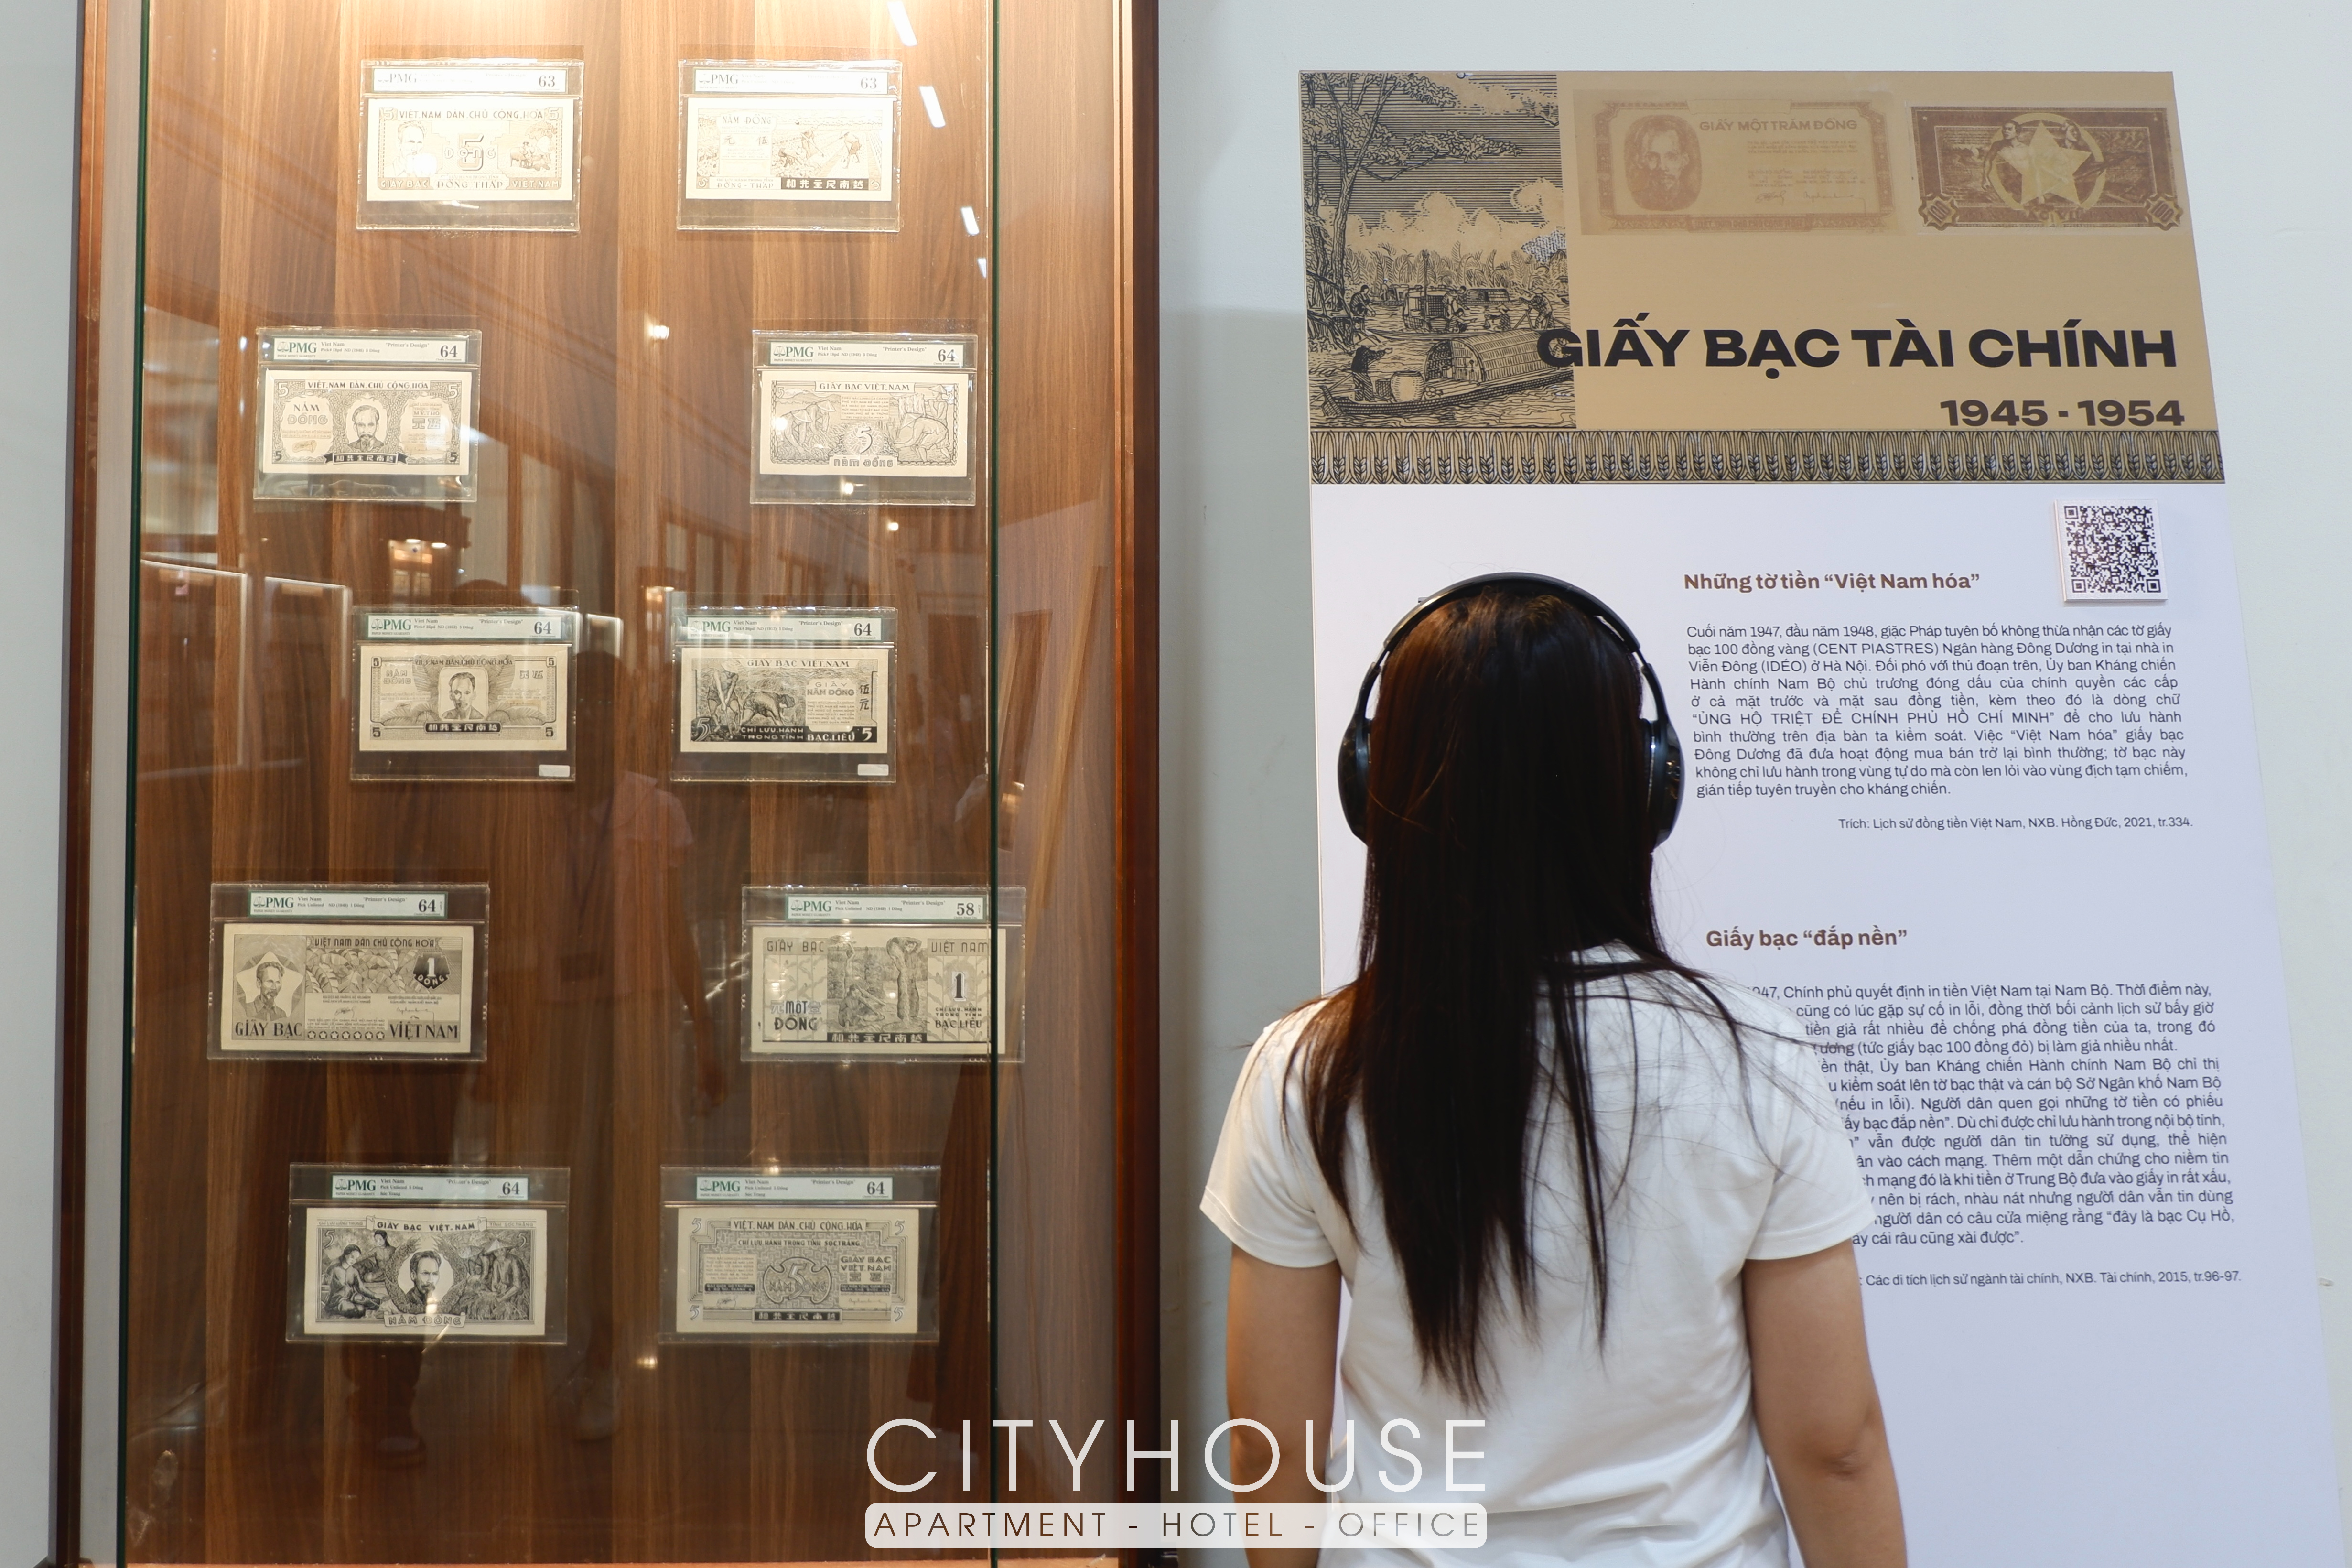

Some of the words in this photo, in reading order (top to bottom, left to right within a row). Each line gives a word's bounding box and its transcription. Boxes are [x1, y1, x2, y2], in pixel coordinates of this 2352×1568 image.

[539, 75, 556, 87] 63
[711, 74, 738, 84] PMG
[861, 77, 877, 89] 63
[289, 342, 317, 353] PMG
[440, 345, 458, 358] 64
[1537, 312, 1690, 368] GIẤY
[1703, 329, 1839, 379] BẠC
[1851, 319, 1953, 367] TÀI
[1969, 319, 2176, 368] CHÍNH
[786, 346, 814, 357] PMG
[938, 349, 955, 362] 64
[278, 382, 289, 397] 5
[1941, 400, 2048, 426] 1945
[2078, 400, 2184, 426] 1954
[1684, 573, 1752, 593] Những
[1756, 573, 1778, 589] tờ
[1780, 570, 1820, 589] tiền
[1824, 573, 1876, 593] “Việt
[1880, 574, 1928, 588] Nam
[1932, 573, 1979, 588] hóa”
[384, 619, 411, 630] PMG
[534, 621, 551, 634] 64
[703, 621, 731, 632] PMG
[854, 623, 872, 636] 64
[1687, 623, 1715, 637] Cuối
[1719, 626, 1747, 637] năm
[1750, 626, 1782, 638] 1947,
[1786, 623, 1809, 637] đầu
[1812, 626, 1839, 637] năm
[1843, 626, 1877, 638] 1948,
[1881, 626, 1906, 639] giặc
[1910, 625, 1942, 638] Pháp
[1944, 625, 1979, 638] tuyên
[1982, 622, 1998, 636] bố
[2001, 625, 2040, 638] không
[2042, 625, 2070, 636] thừa
[2073, 625, 2104, 638] nhận
[2107, 625, 2129, 636] các
[2131, 625, 2145, 636] tờ
[2147, 622, 2171, 638] giấy
[862, 727, 872, 741] 5
[1838, 819, 1869, 828] Trích:
[1873, 818, 1897, 831] Lịch
[1899, 818, 1913, 828] sử
[1915, 816, 1945, 830] đồng
[1947, 816, 1967, 828] tiền
[1970, 818, 1992, 830] Việt
[1995, 818, 2025, 829] Nam,
[2028, 818, 2058, 827] NXB.
[2061, 815, 2093, 830] Hồng
[2094, 817, 2121, 828] Đức,
[2124, 817, 2155, 828] 2021,
[2158, 817, 2193, 827] tr.334.
[266, 897, 294, 908] PMG
[419, 899, 436, 912] 64
[803, 900, 831, 912] PMG
[957, 903, 975, 916] 58
[334, 938, 352, 946] NAM
[1706, 926, 1754, 950] Giấy
[1759, 930, 1798, 950] bạc
[1803, 925, 1853, 950] “đắp
[1858, 925, 1907, 945] nền”
[802, 941, 824, 955] BẠC
[931, 941, 955, 953] VIỆT
[961, 941, 988, 952] NAM
[427, 957, 436, 977] 1
[954, 973, 966, 1001] 1
[1784, 986, 1823, 998] Chính
[1827, 985, 1852, 1000] phủ
[1856, 983, 1893, 1000] quyết
[1896, 985, 1925, 1000] định
[1928, 985, 1940, 997] in
[1943, 982, 1968, 997] tiền
[1971, 984, 1997, 999] Việt
[2000, 985, 2032, 996] Nam
[2035, 984, 2051, 999] tại
[2055, 985, 2087, 996] Nam
[2090, 984, 2113, 998] Bộ.
[2115, 984, 2146, 995] Thời
[2149, 980, 2182, 995] điểm
[2185, 983, 2211, 997] này,
[274, 1022, 302, 1039] BẠC
[425, 1024, 458, 1039] NAM
[347, 1179, 376, 1191] PMG
[502, 1181, 520, 1195] 64
[712, 1180, 740, 1192] PMG
[867, 1181, 885, 1195] 64
[1866, 1275, 1890, 1286] Các
[1892, 1274, 1903, 1285] di
[1906, 1274, 1927, 1285] tích
[1930, 1274, 1950, 1287] lịch
[1953, 1274, 1968, 1285] sử
[1970, 1273, 2007, 1287] ngành
[2009, 1273, 2024, 1284] tài
[2027, 1273, 2062, 1285] chính,
[2066, 1273, 2096, 1283] NXB.
[2099, 1272, 2117, 1283] Tài
[2120, 1272, 2155, 1284] chính,
[2158, 1271, 2191, 1283] 2015,
[2194, 1271, 2241, 1282] tr.96-97.
